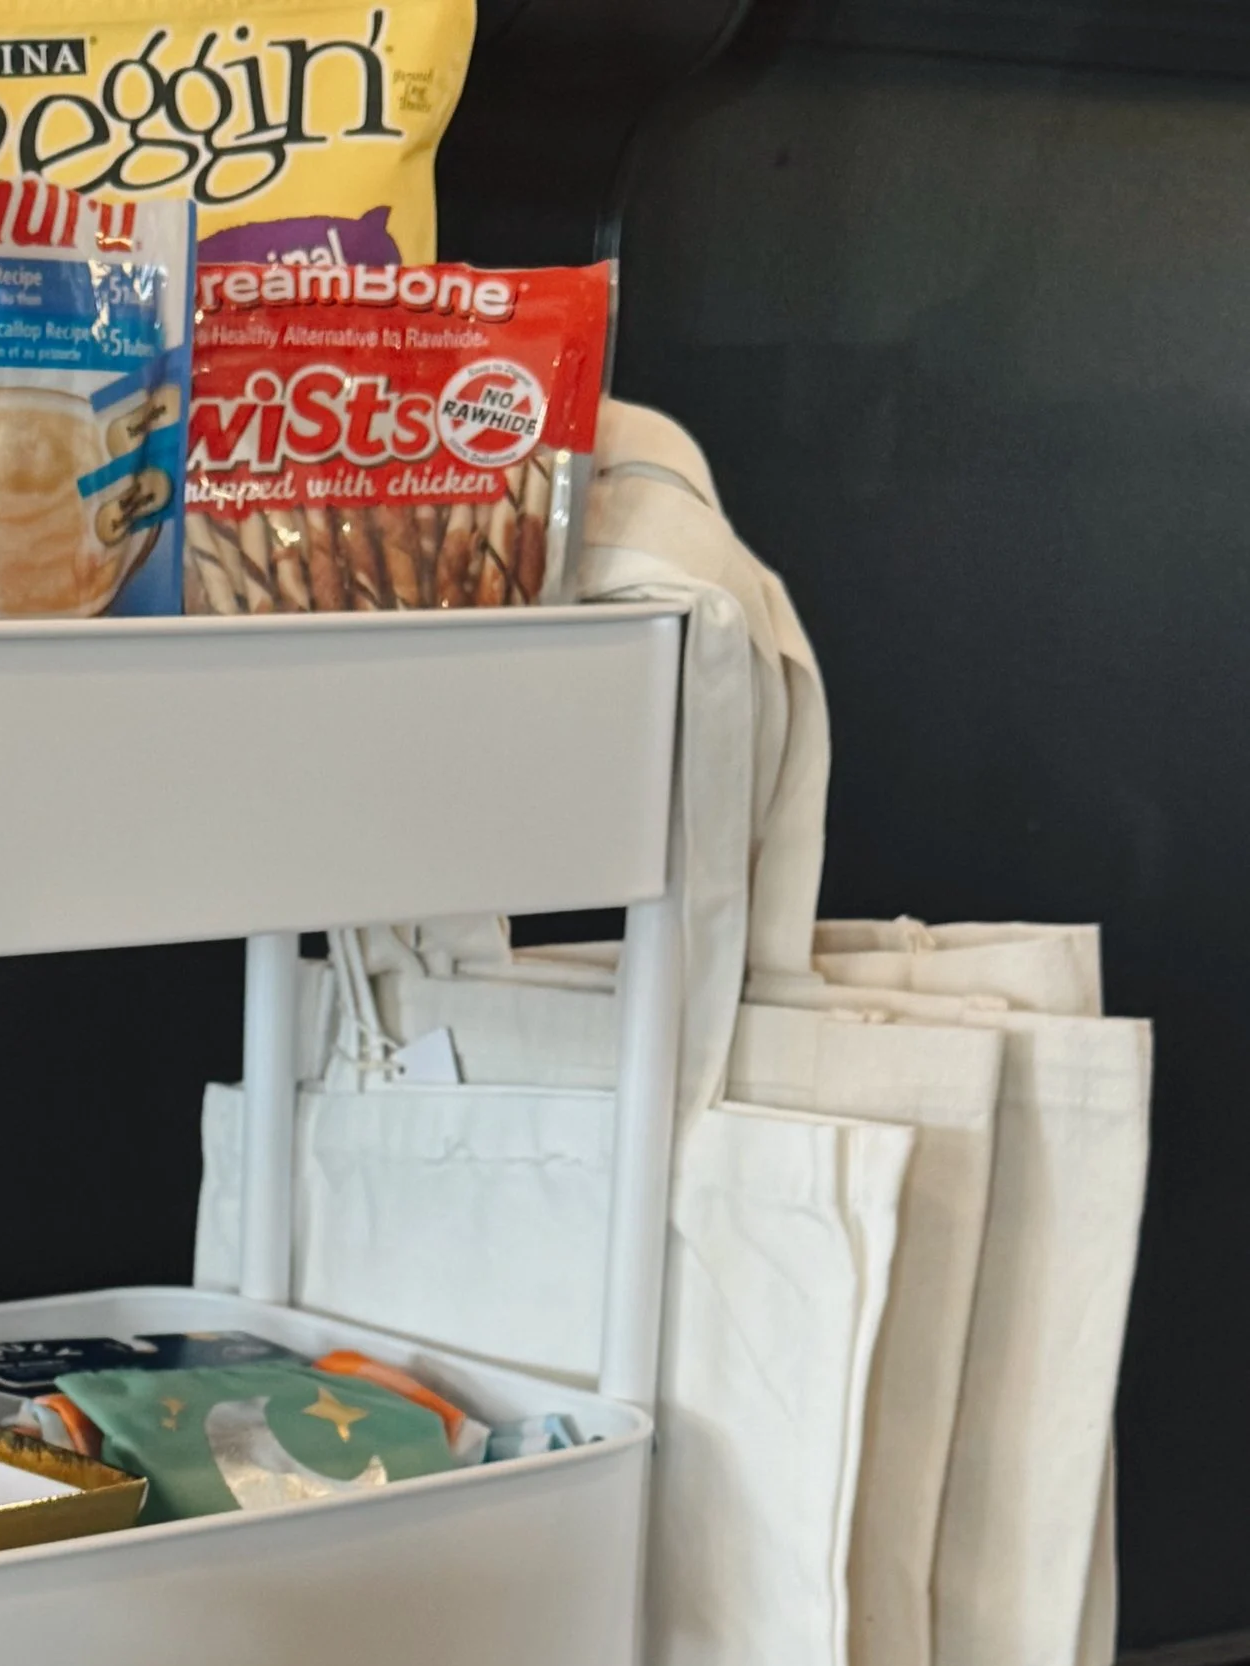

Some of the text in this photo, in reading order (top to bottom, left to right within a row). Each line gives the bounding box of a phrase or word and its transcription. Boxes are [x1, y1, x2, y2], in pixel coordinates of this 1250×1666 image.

[200, 264, 510, 317] reamBone
[212, 323, 279, 349] Healthy
[283, 323, 378, 348] Alternative
[483, 388, 515, 409] NO
[442, 400, 538, 436] RAWHIDE
[307, 467, 376, 498] with
[387, 464, 499, 498] chicken
